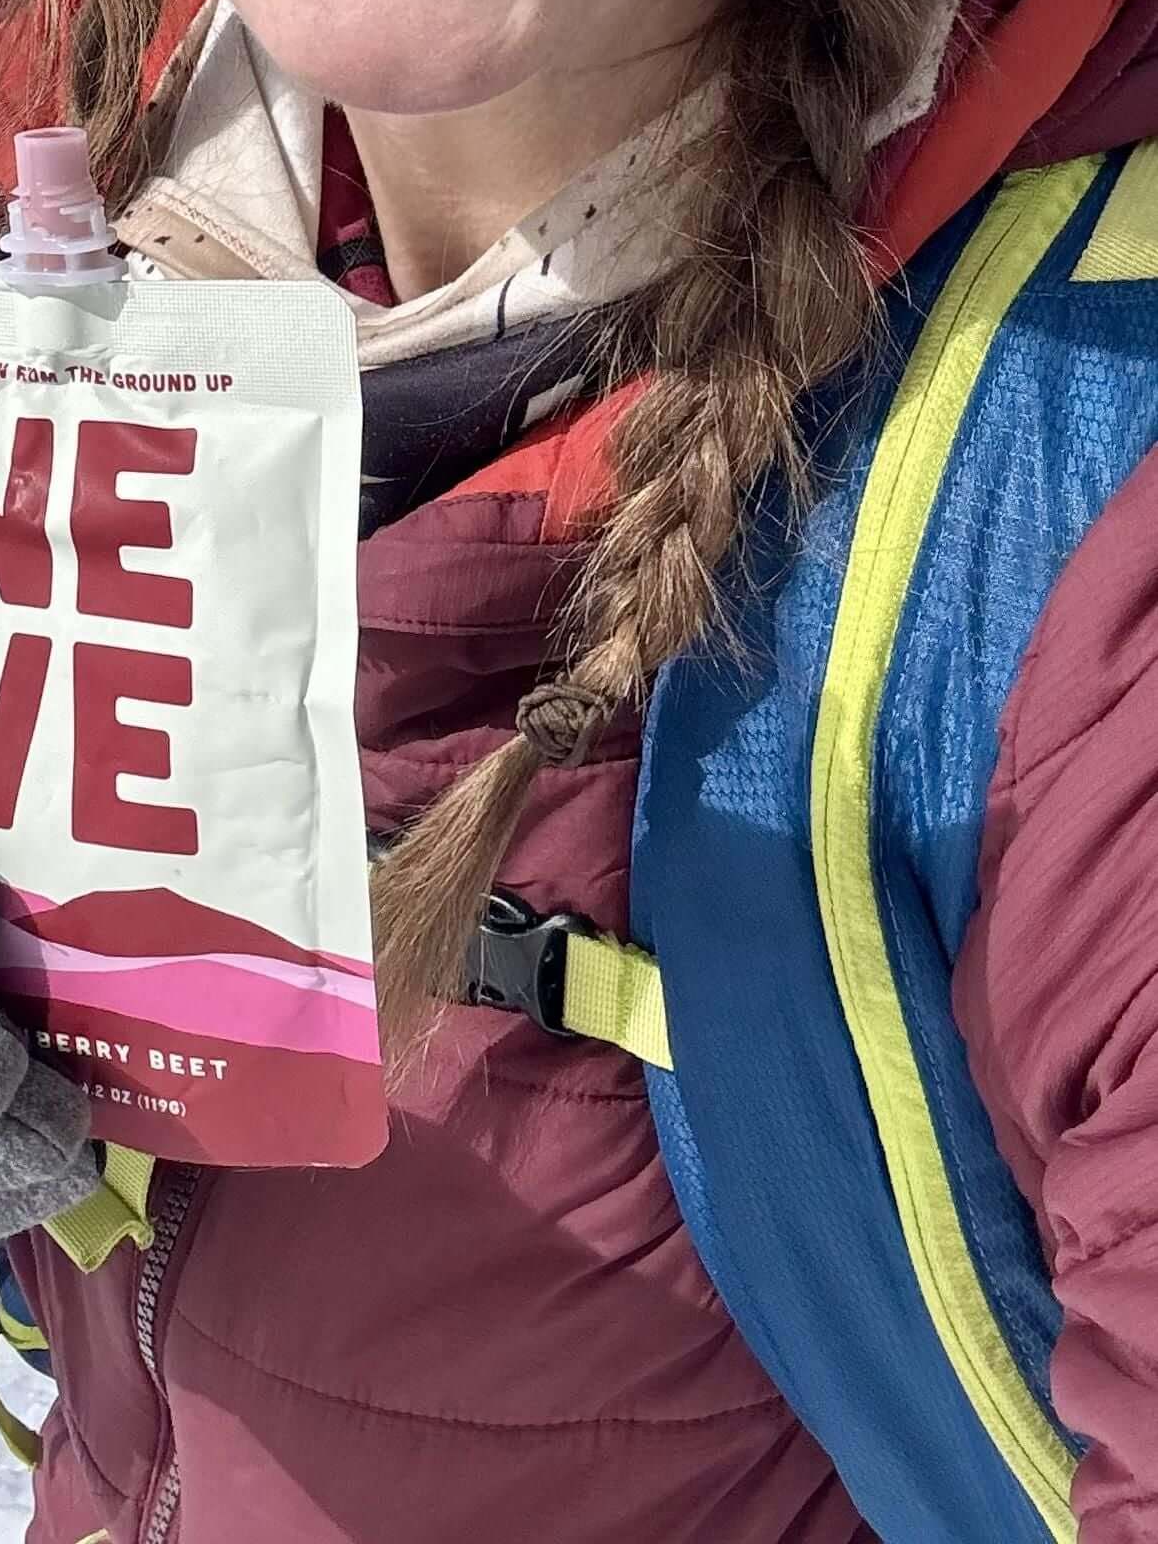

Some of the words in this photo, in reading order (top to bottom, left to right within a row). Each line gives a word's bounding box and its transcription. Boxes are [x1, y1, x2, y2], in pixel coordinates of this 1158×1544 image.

[65, 365, 106, 386] THE
[112, 372, 196, 393] GROUND
[206, 374, 233, 393] UP
[24, 1028, 130, 1064] BERRY
[148, 1048, 228, 1081] BEET
[110, 1087, 132, 1105] OZ
[137, 1093, 188, 1118] (119G)
